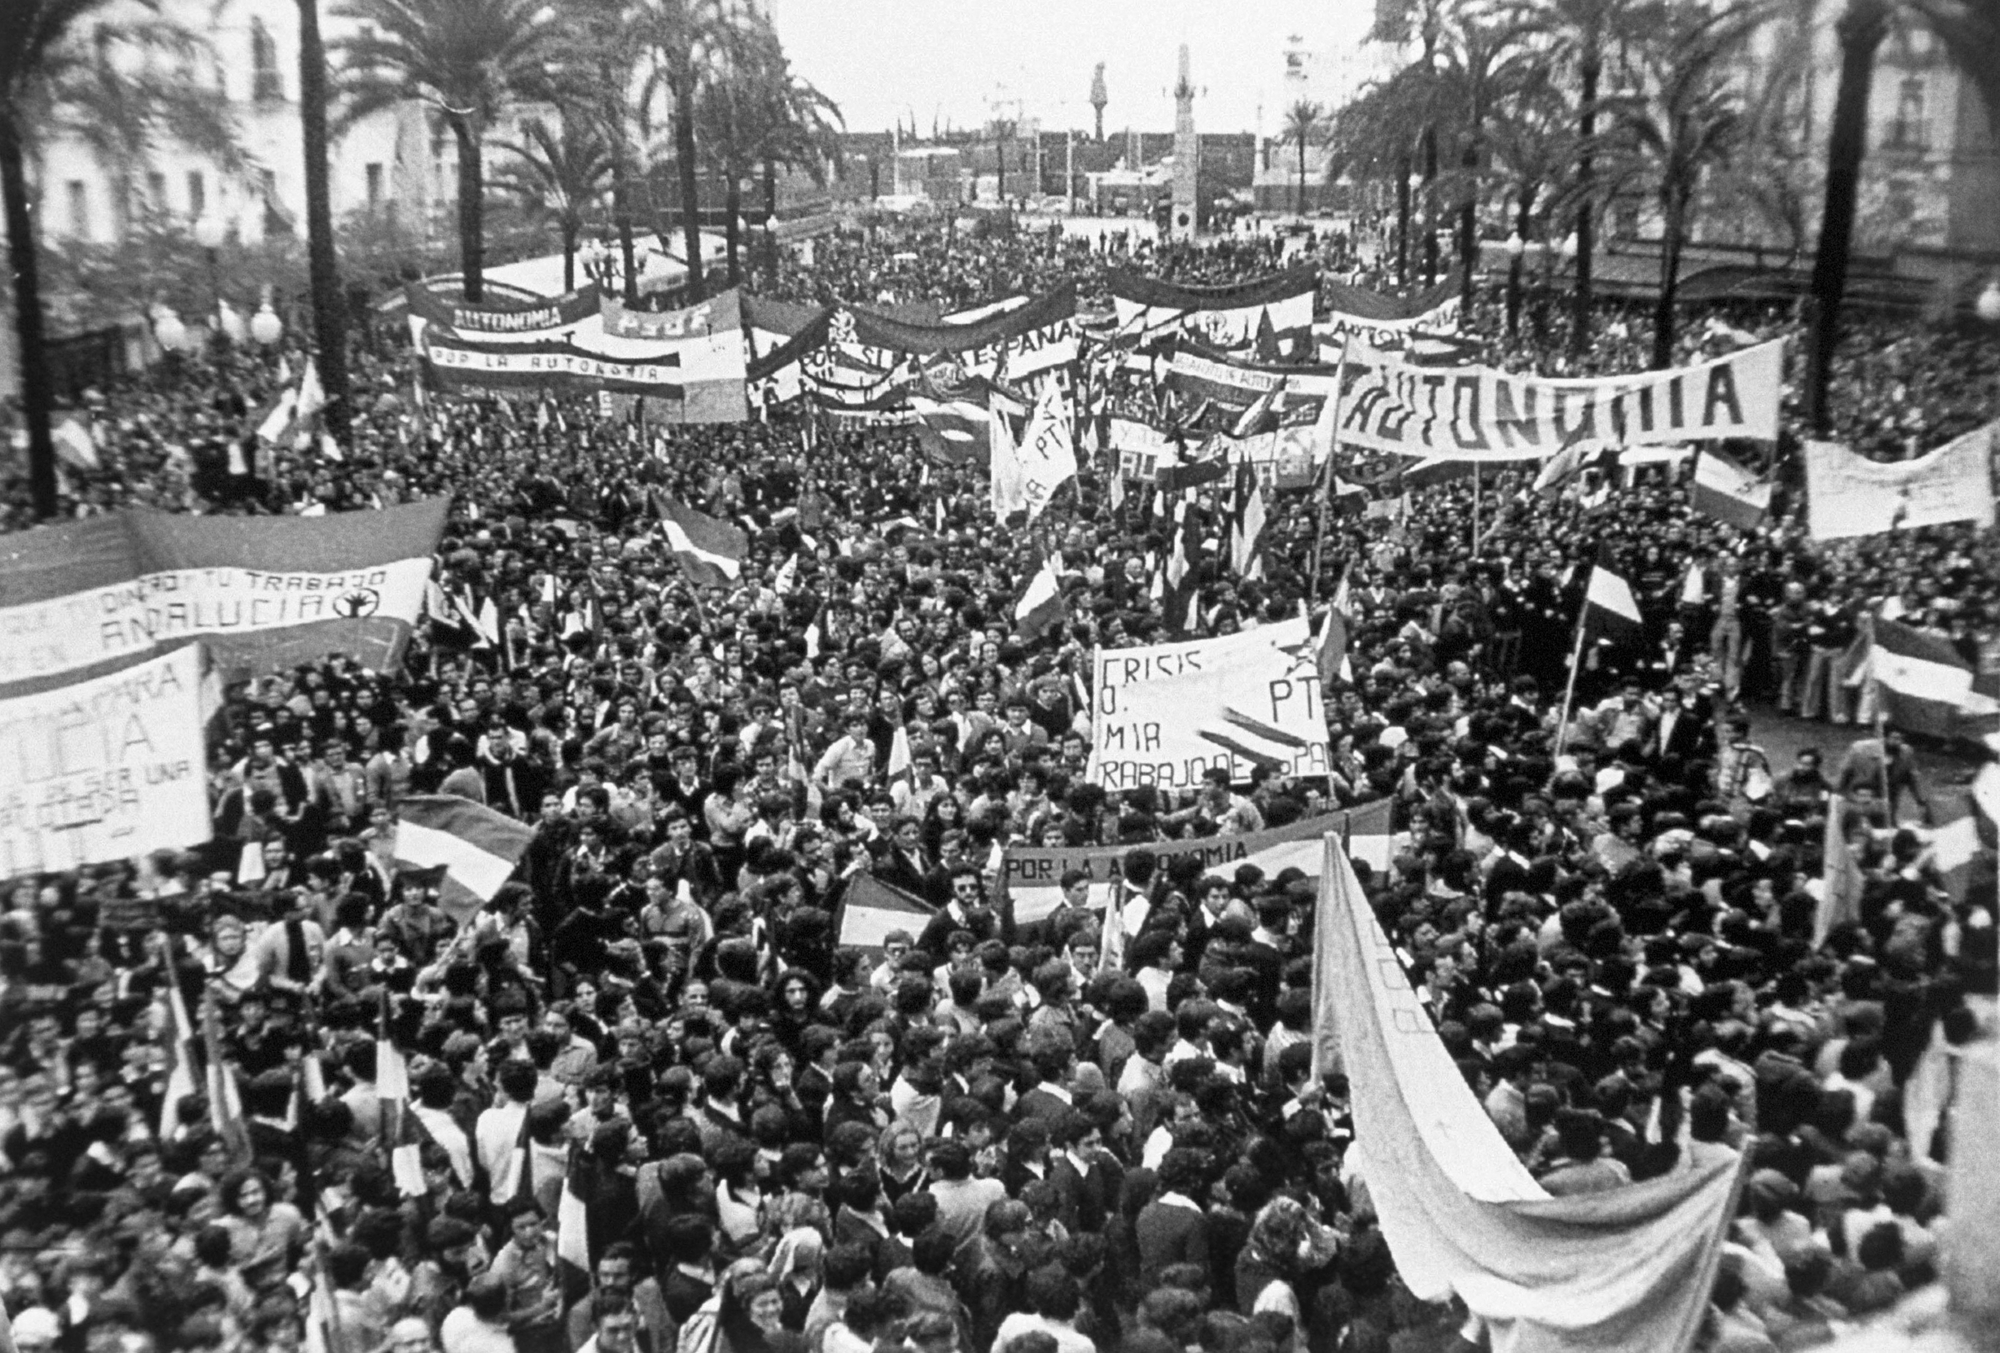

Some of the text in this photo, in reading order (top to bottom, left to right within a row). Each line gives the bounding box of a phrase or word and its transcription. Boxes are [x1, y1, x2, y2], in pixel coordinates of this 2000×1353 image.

[453, 307, 562, 331] AUTONOMIA
[485, 356, 509, 368] LA
[531, 357, 658, 381] AUTONOMIA
[245, 571, 387, 591] TRABAJO
[101, 594, 325, 651] ANDALUCIA
[1269, 675, 1321, 723] PT
[1100, 757, 1206, 789] RABAJO
[1006, 859, 1054, 880] POR
